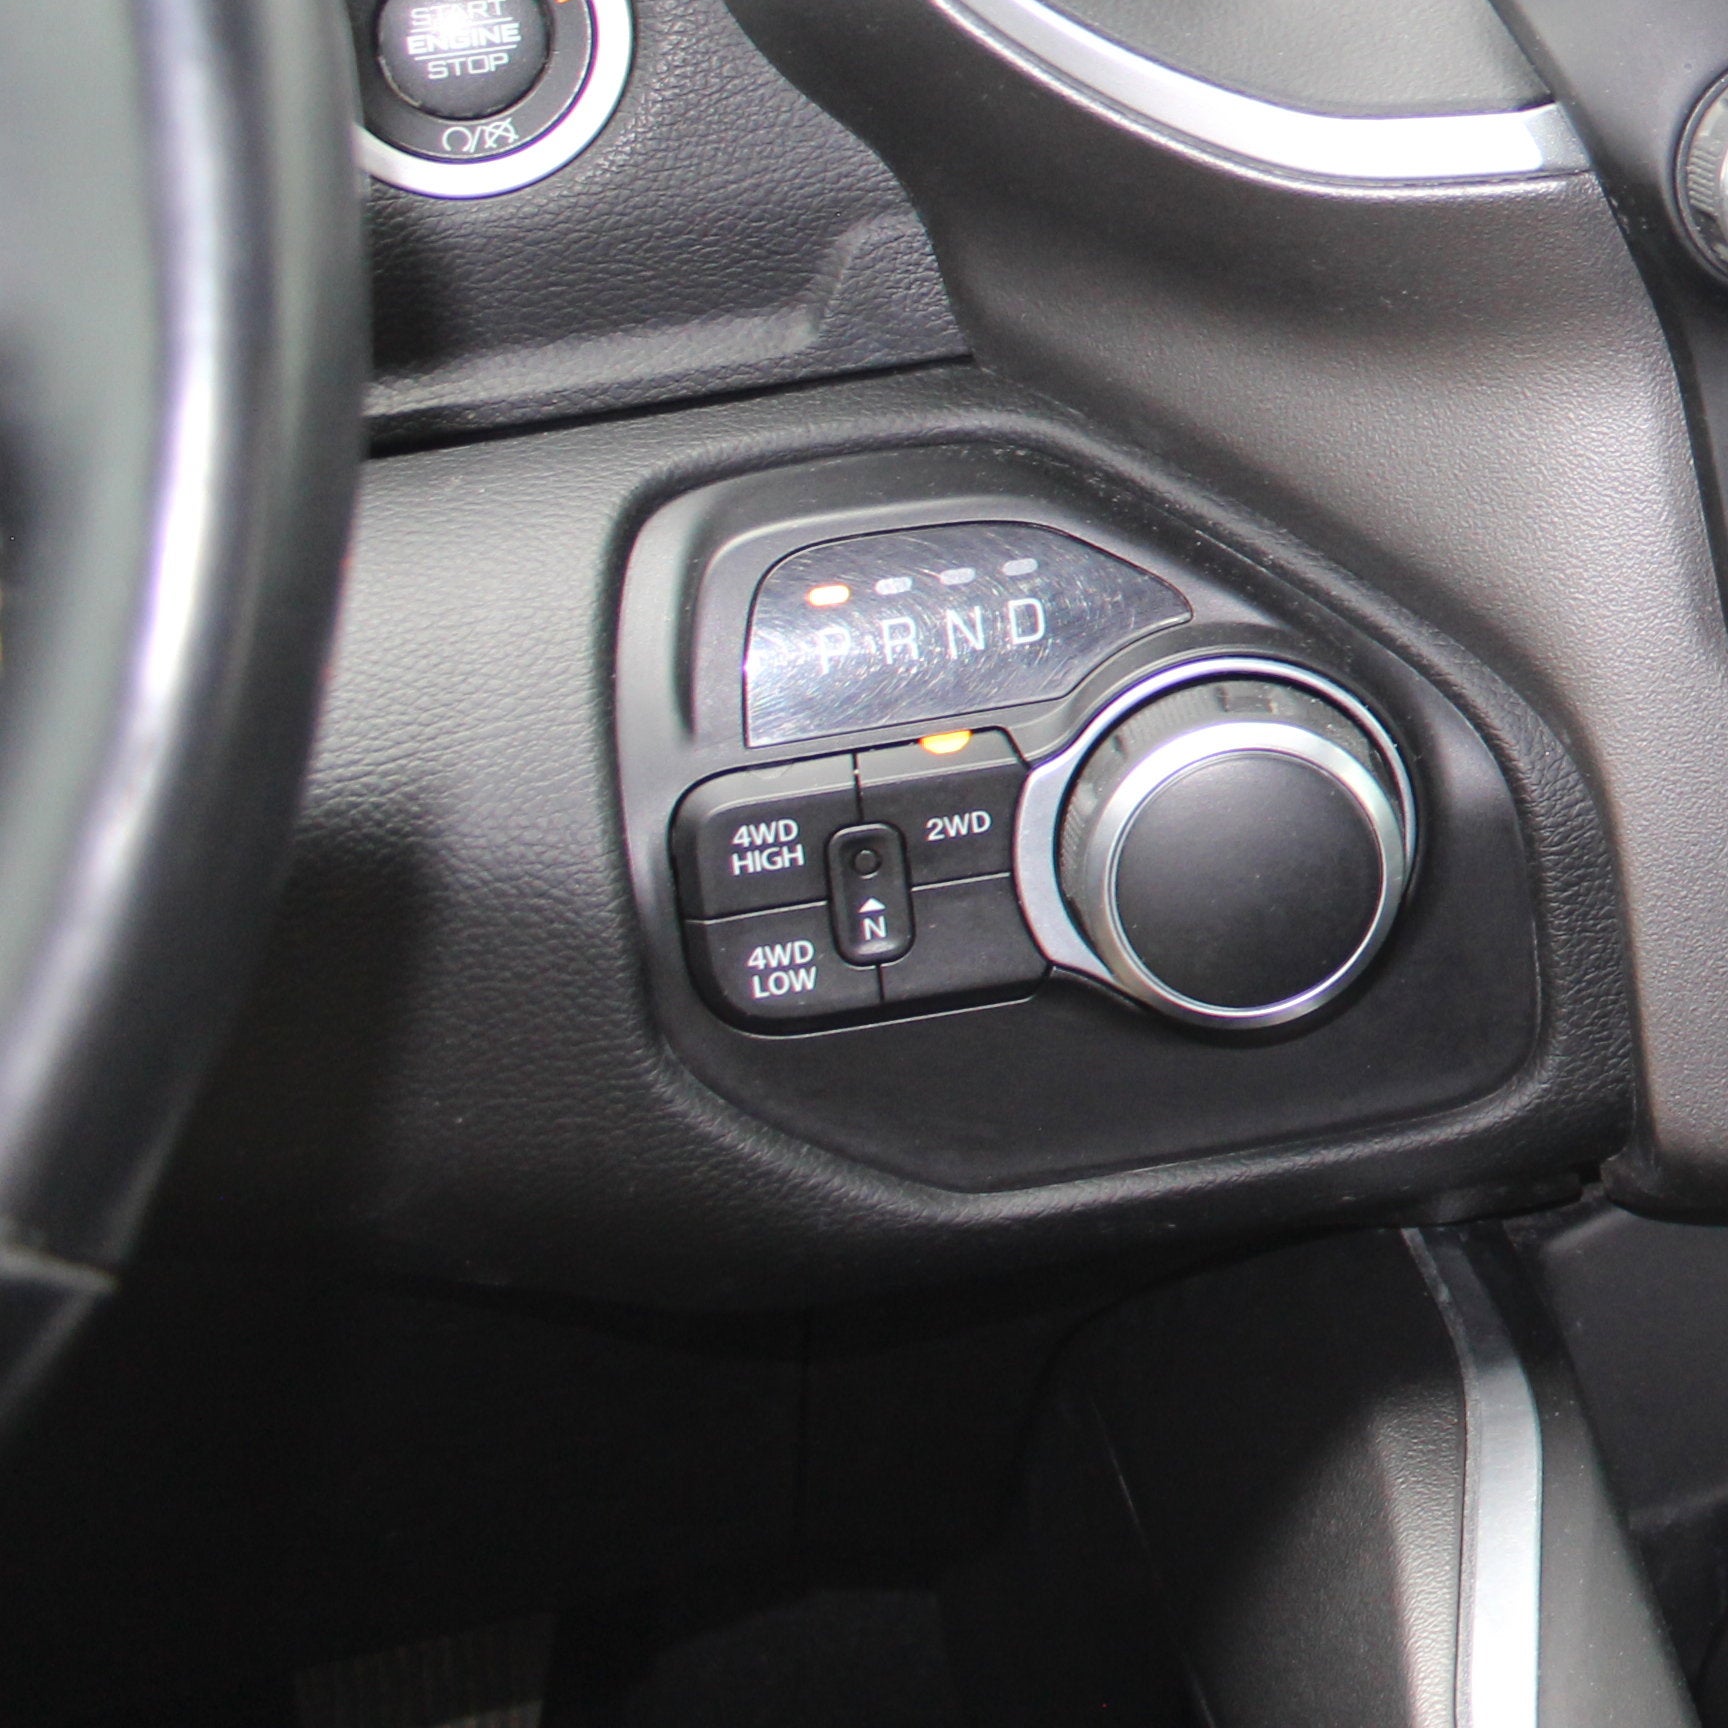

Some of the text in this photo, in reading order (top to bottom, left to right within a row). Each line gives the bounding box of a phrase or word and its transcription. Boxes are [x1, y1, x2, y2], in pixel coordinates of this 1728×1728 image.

[405, 21, 522, 56] ENGINE
[427, 51, 510, 80] STOP
[815, 597, 1046, 674] P R N D
[731, 818, 799, 849] 4WD
[925, 810, 992, 843] 2WD
[731, 843, 805, 876] HIGH
[862, 916, 887, 940] N
[746, 939, 815, 971] 4WD
[751, 965, 817, 1000] LOW
